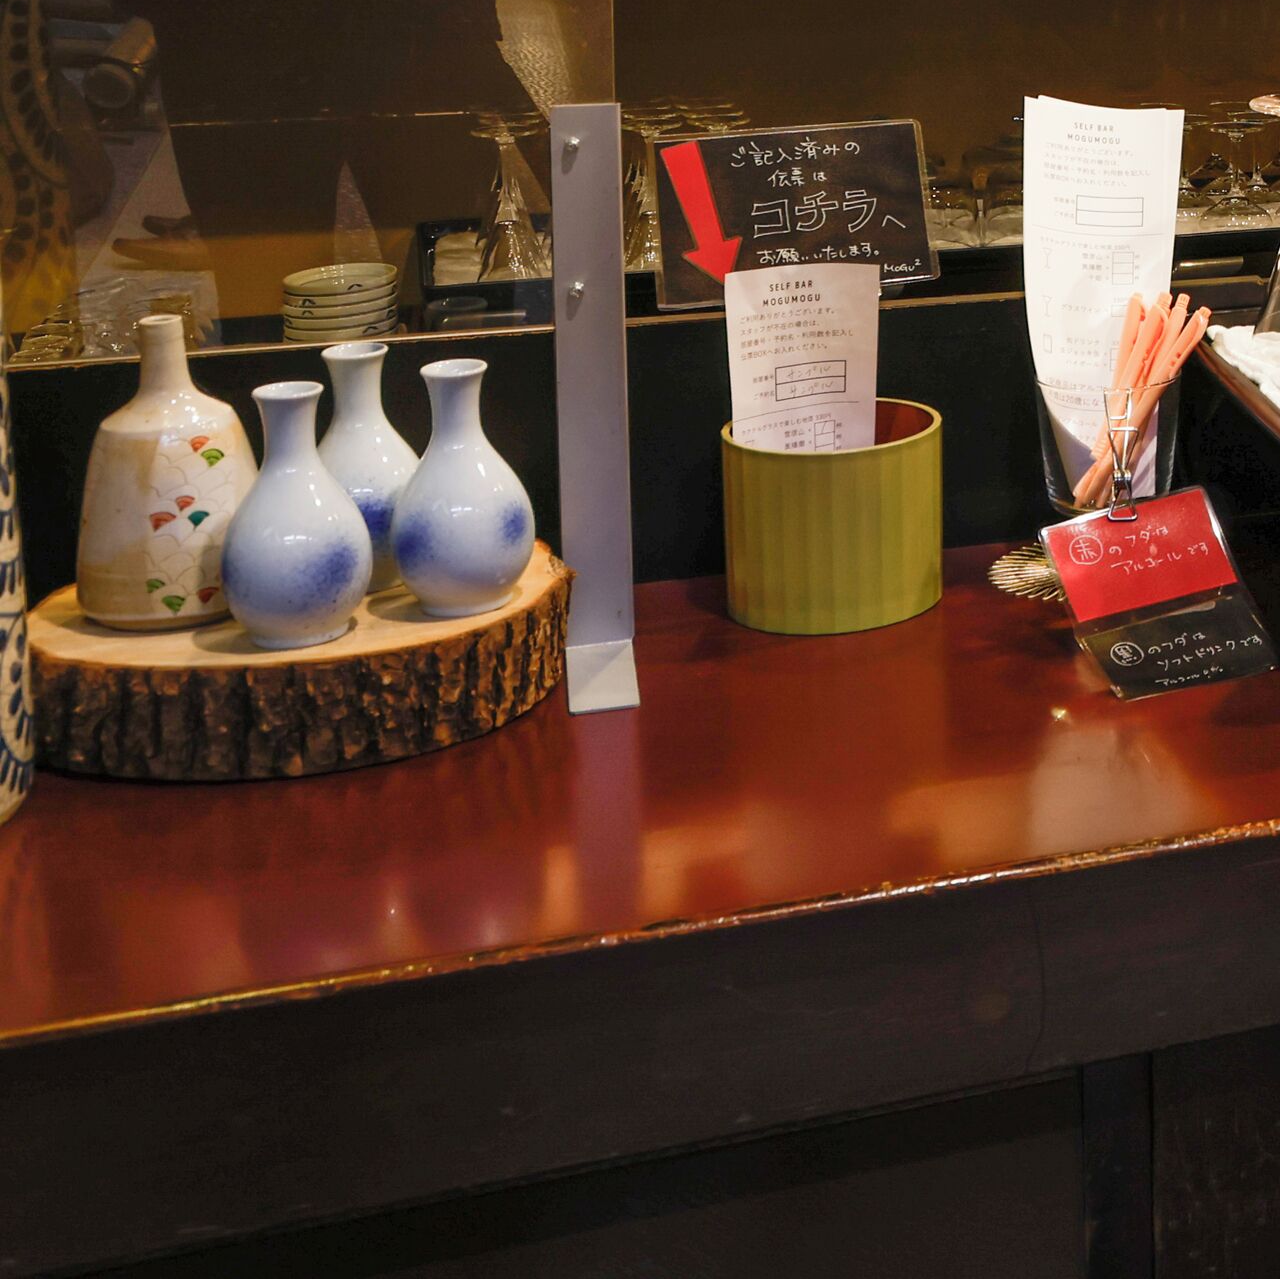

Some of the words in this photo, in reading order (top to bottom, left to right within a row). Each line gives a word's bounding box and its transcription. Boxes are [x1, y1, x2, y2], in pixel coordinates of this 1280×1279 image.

[1074, 122, 1093, 131] SELF
[1097, 124, 1115, 132] BAR
[1067, 133, 1121, 145] MOGUMOGU
[730, 136, 861, 168] ご記入済みの
[767, 167, 828, 187] 伝票は
[751, 189, 907, 239] コチラへ
[769, 281, 790, 292] SELF
[795, 280, 813, 289] BAR
[763, 294, 821, 307] MOGUMOGU
[1157, 634, 1263, 671] ソフトドリンクです
